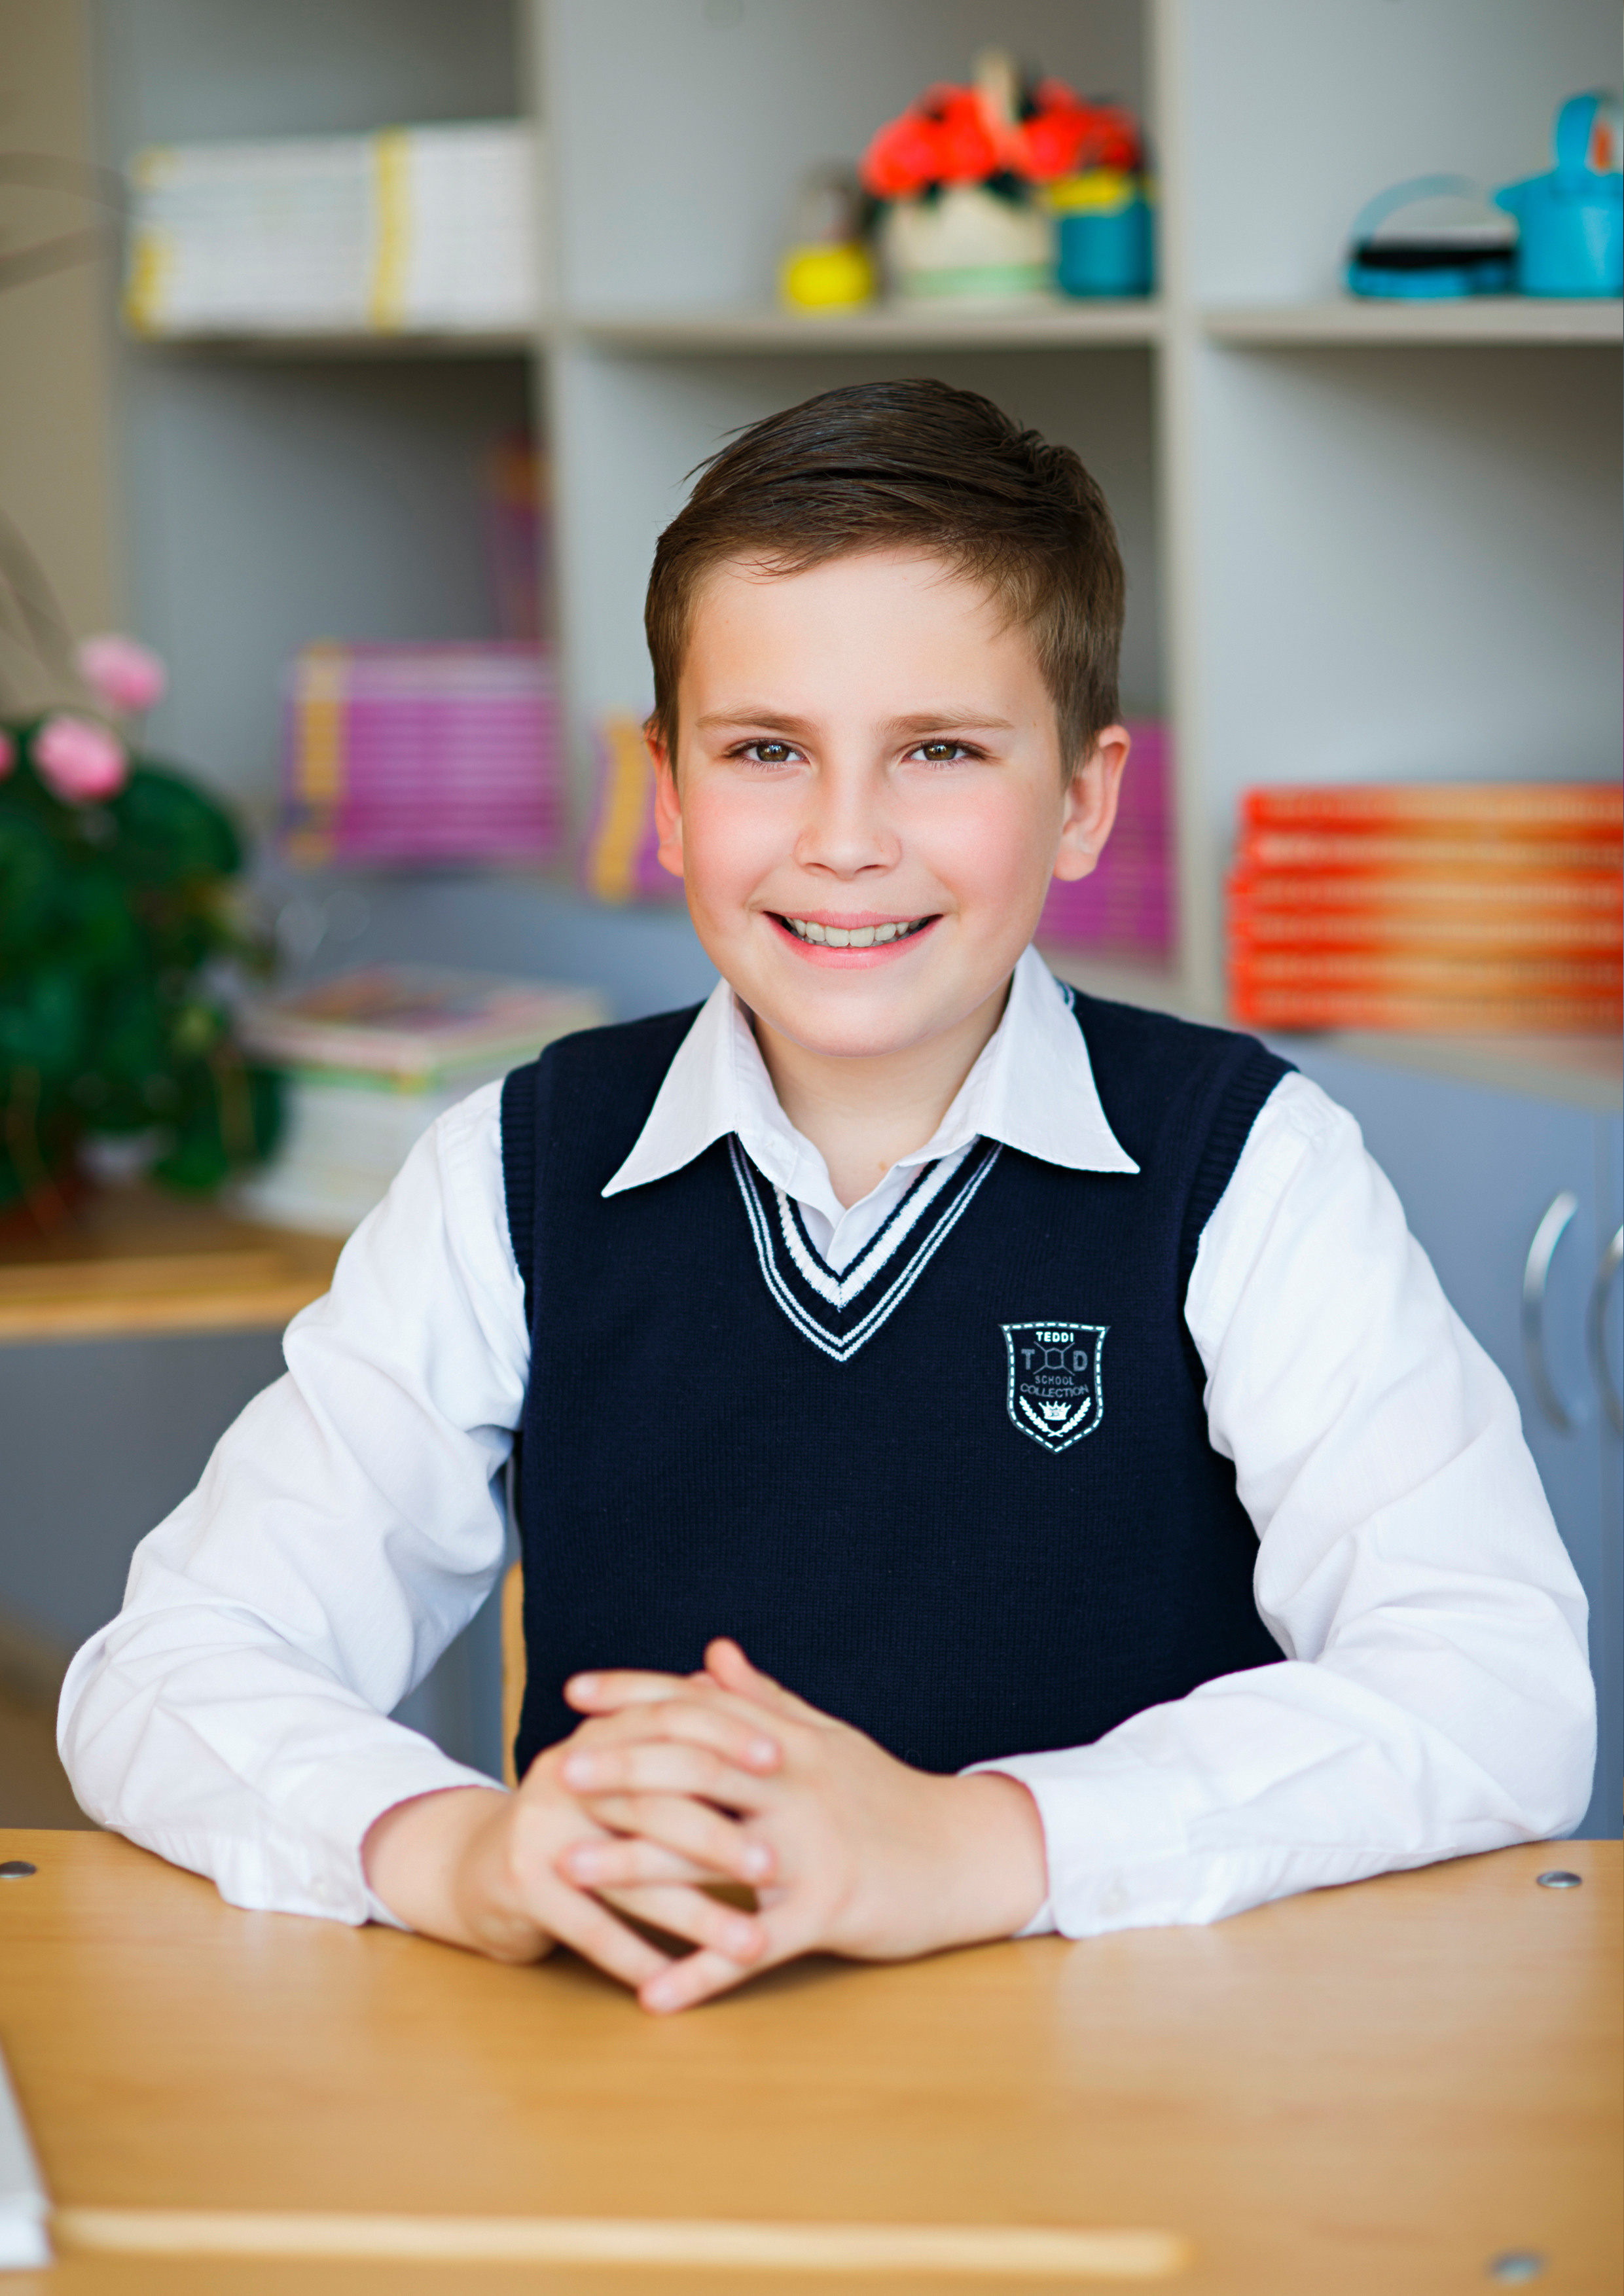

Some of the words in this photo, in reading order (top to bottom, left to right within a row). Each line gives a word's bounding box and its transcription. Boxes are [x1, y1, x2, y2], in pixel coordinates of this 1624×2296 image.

[1036, 1331, 1074, 1342] TEDDI
[1021, 1349, 1035, 1370] T
[1073, 1350, 1088, 1372] D
[1035, 1375, 1074, 1385] SCHOOL
[1020, 1383, 1089, 1398] COLLECTION
